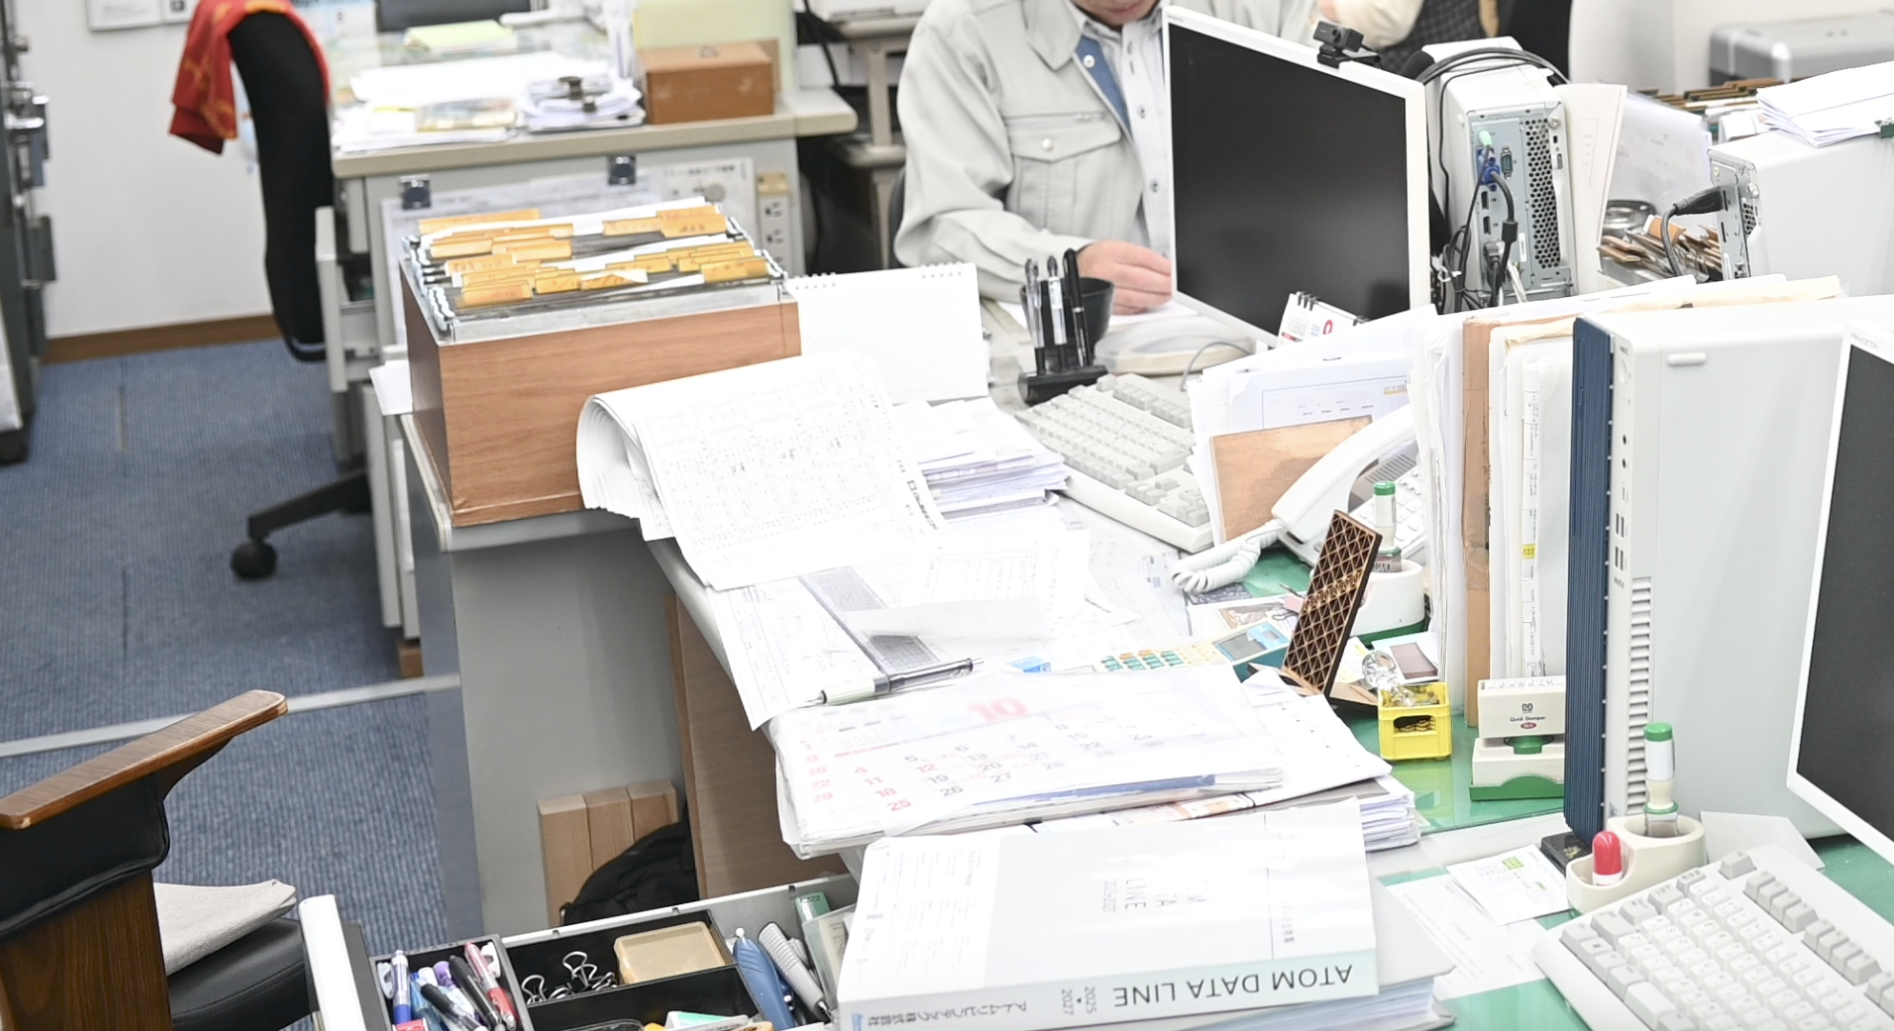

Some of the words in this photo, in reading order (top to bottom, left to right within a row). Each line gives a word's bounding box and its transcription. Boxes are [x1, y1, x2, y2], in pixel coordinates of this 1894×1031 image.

[968, 697, 1028, 723] 10
[904, 754, 919, 763] 5
[863, 776, 884, 786] 11
[915, 764, 937, 774] 12
[875, 787, 898, 799] 18
[927, 774, 949, 784] 19
[979, 762, 1002, 772] 20
[887, 799, 912, 812] 25
[939, 785, 965, 797] 26
[990, 772, 1014, 783] 27
[1124, 877, 1148, 911] LINE
[1185, 973, 1261, 999] DATA
[1270, 963, 1355, 991] ATOM
[1061, 989, 1074, 1017] 2027
[1084, 986, 1097, 1015] 2025
[1112, 982, 1175, 1009] LINE
